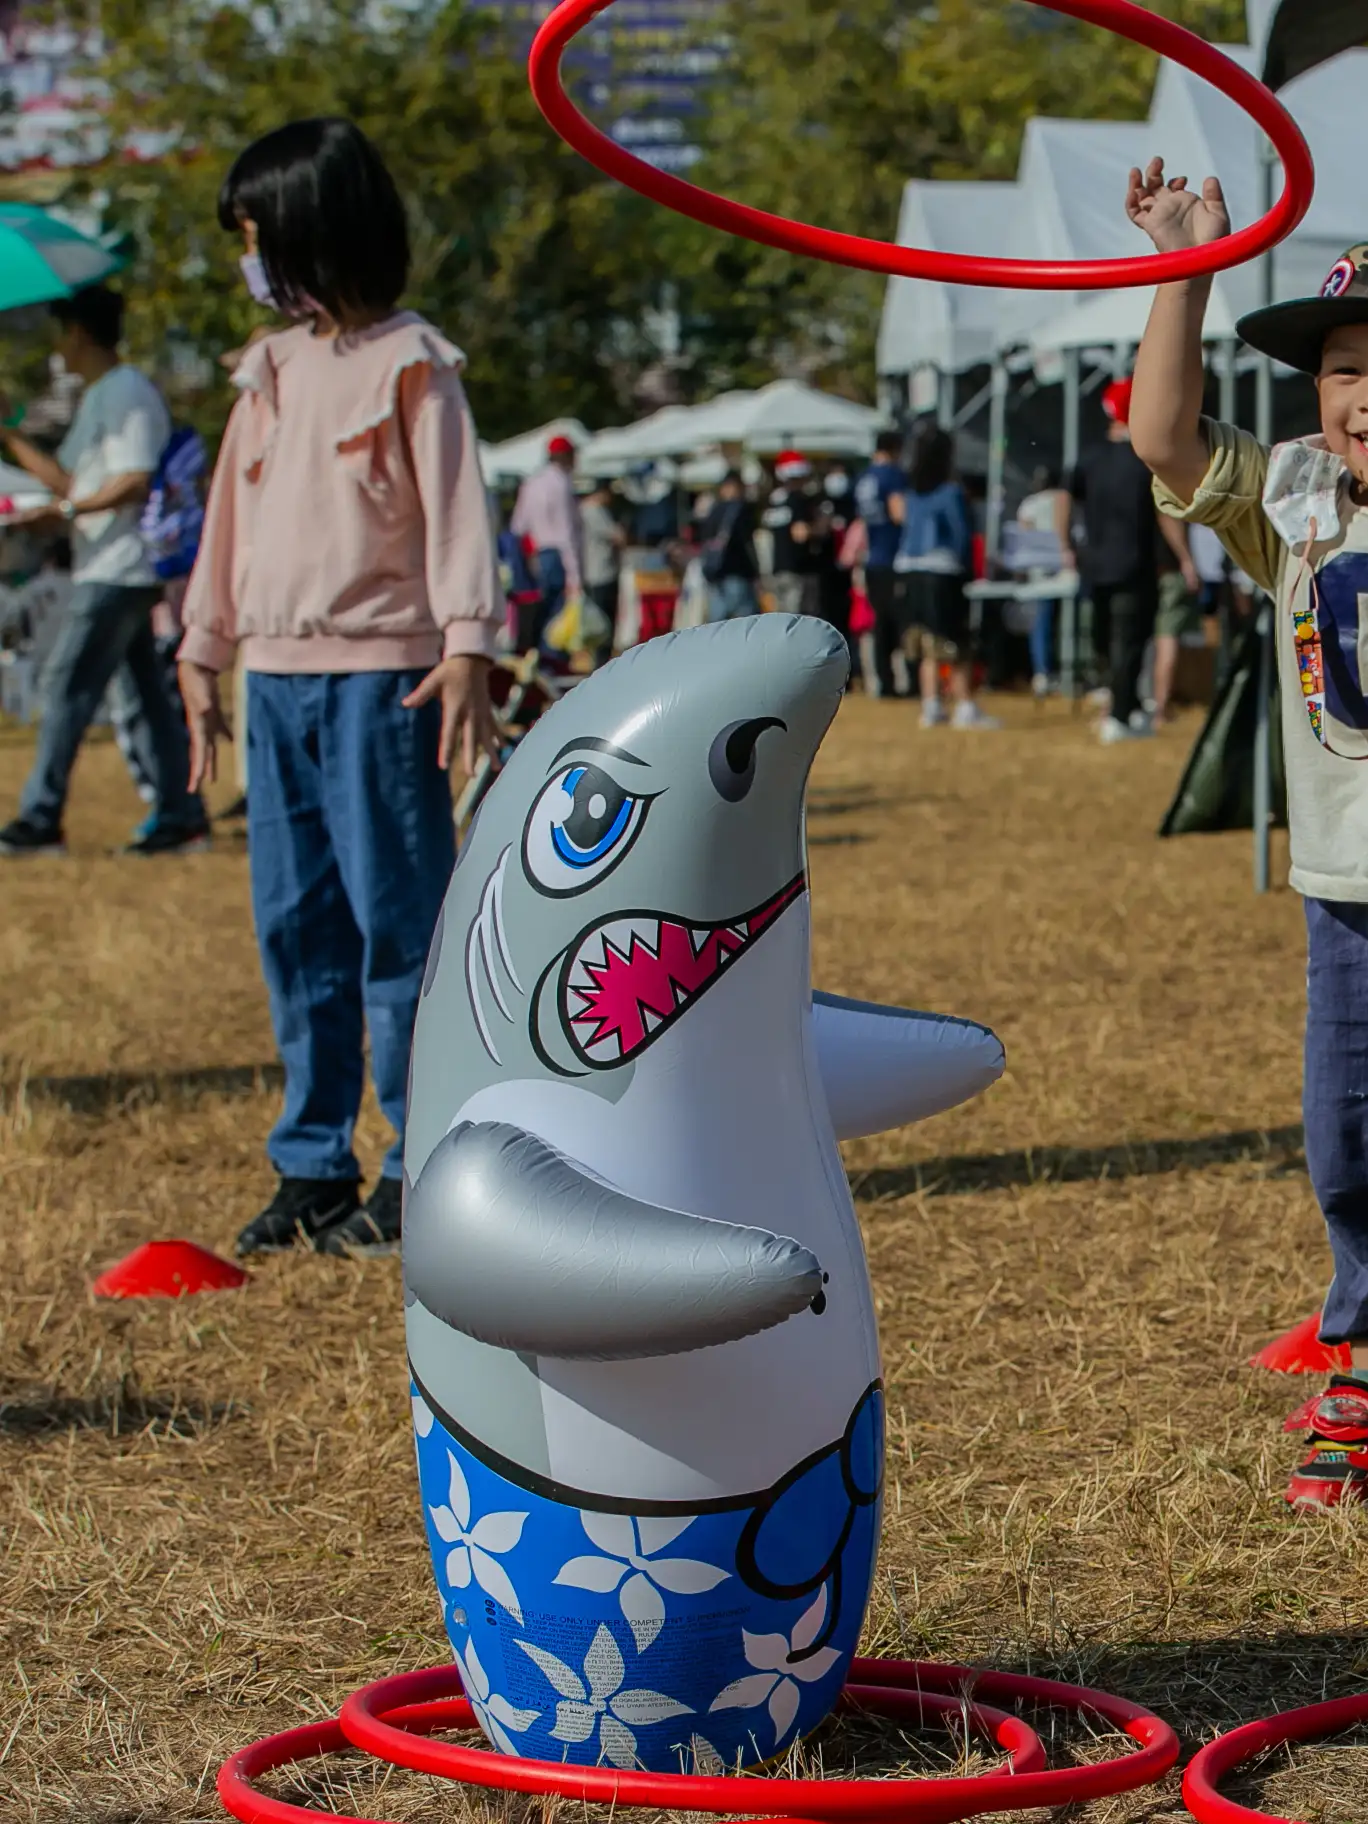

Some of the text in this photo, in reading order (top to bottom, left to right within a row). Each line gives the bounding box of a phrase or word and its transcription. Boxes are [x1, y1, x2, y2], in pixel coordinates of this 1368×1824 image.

[539, 1613, 557, 1621] USE
[560, 1616, 583, 1625] ONLY
[587, 1619, 620, 1627] UNDER
[624, 1617, 683, 1627] COMPETENT
